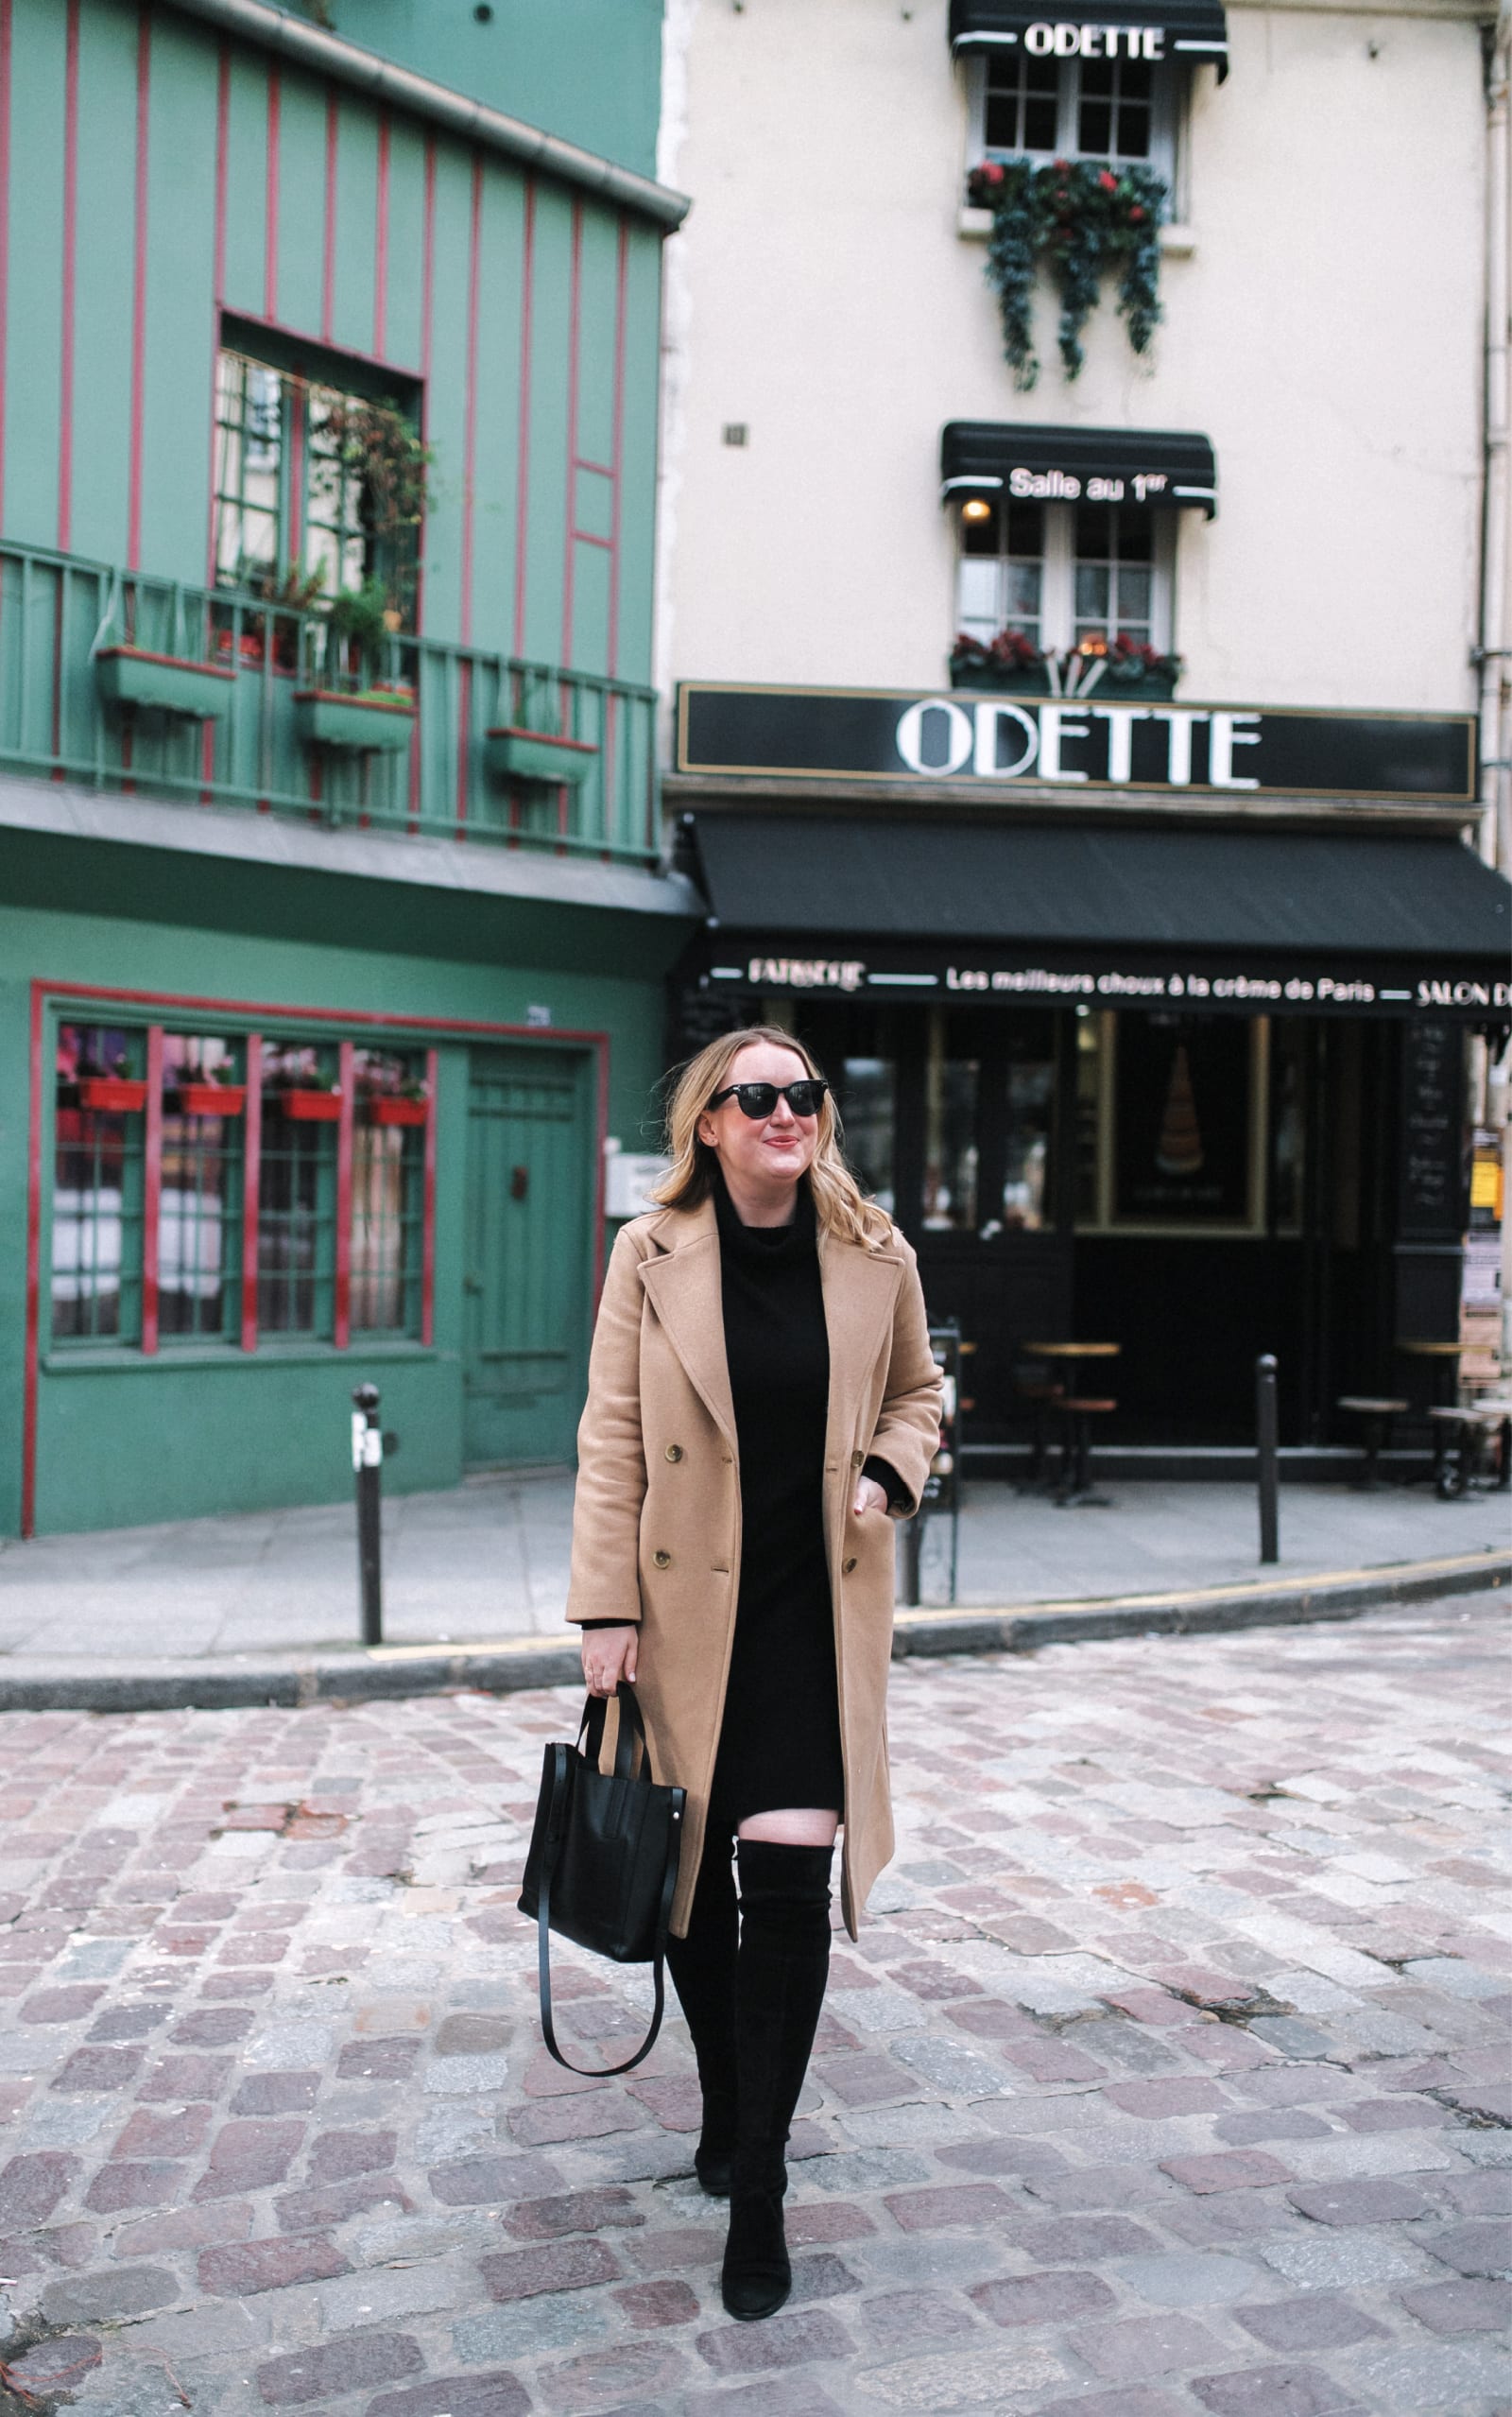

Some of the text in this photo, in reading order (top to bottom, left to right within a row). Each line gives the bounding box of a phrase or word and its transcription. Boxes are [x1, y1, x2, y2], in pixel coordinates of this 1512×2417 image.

[1024, 23, 1164, 60] ODETTE
[1009, 468, 1081, 499] Salle
[1087, 478, 1125, 501] au
[897, 699, 1262, 789] ODETTE
[947, 968, 1375, 1002] Les meilleurs choux à la crème de Paris
[1418, 981, 1489, 1007] SALON
